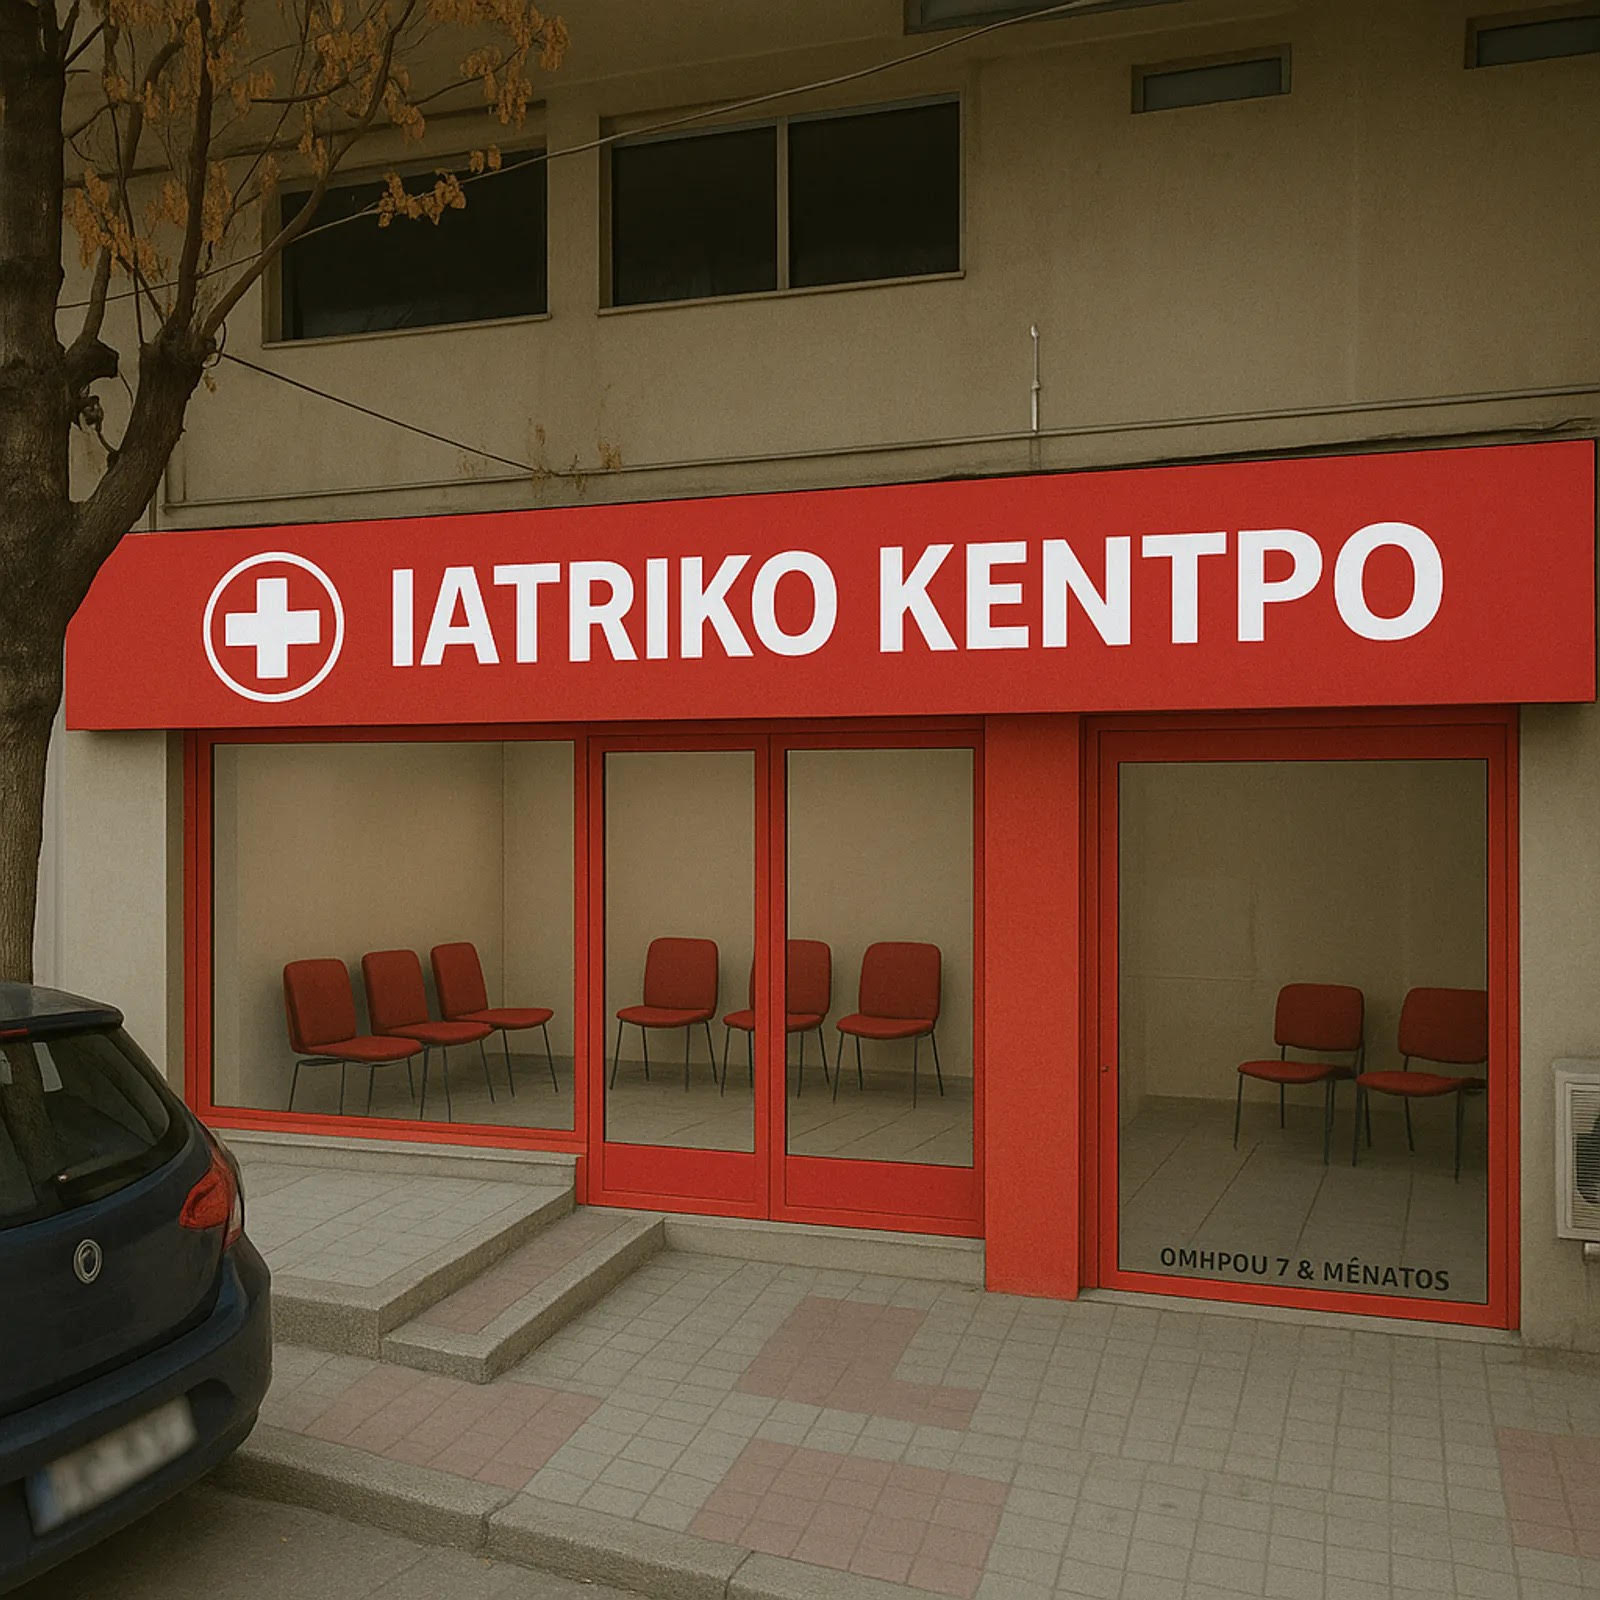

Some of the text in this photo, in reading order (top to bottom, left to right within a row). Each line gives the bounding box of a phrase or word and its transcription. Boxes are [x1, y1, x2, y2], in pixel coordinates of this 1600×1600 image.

[393, 522, 1444, 667] IATRIKO KENTPO
[1160, 1247, 1268, 1275] OMHPOU
[1276, 1257, 1290, 1277] 7
[1297, 1259, 1315, 1281] &
